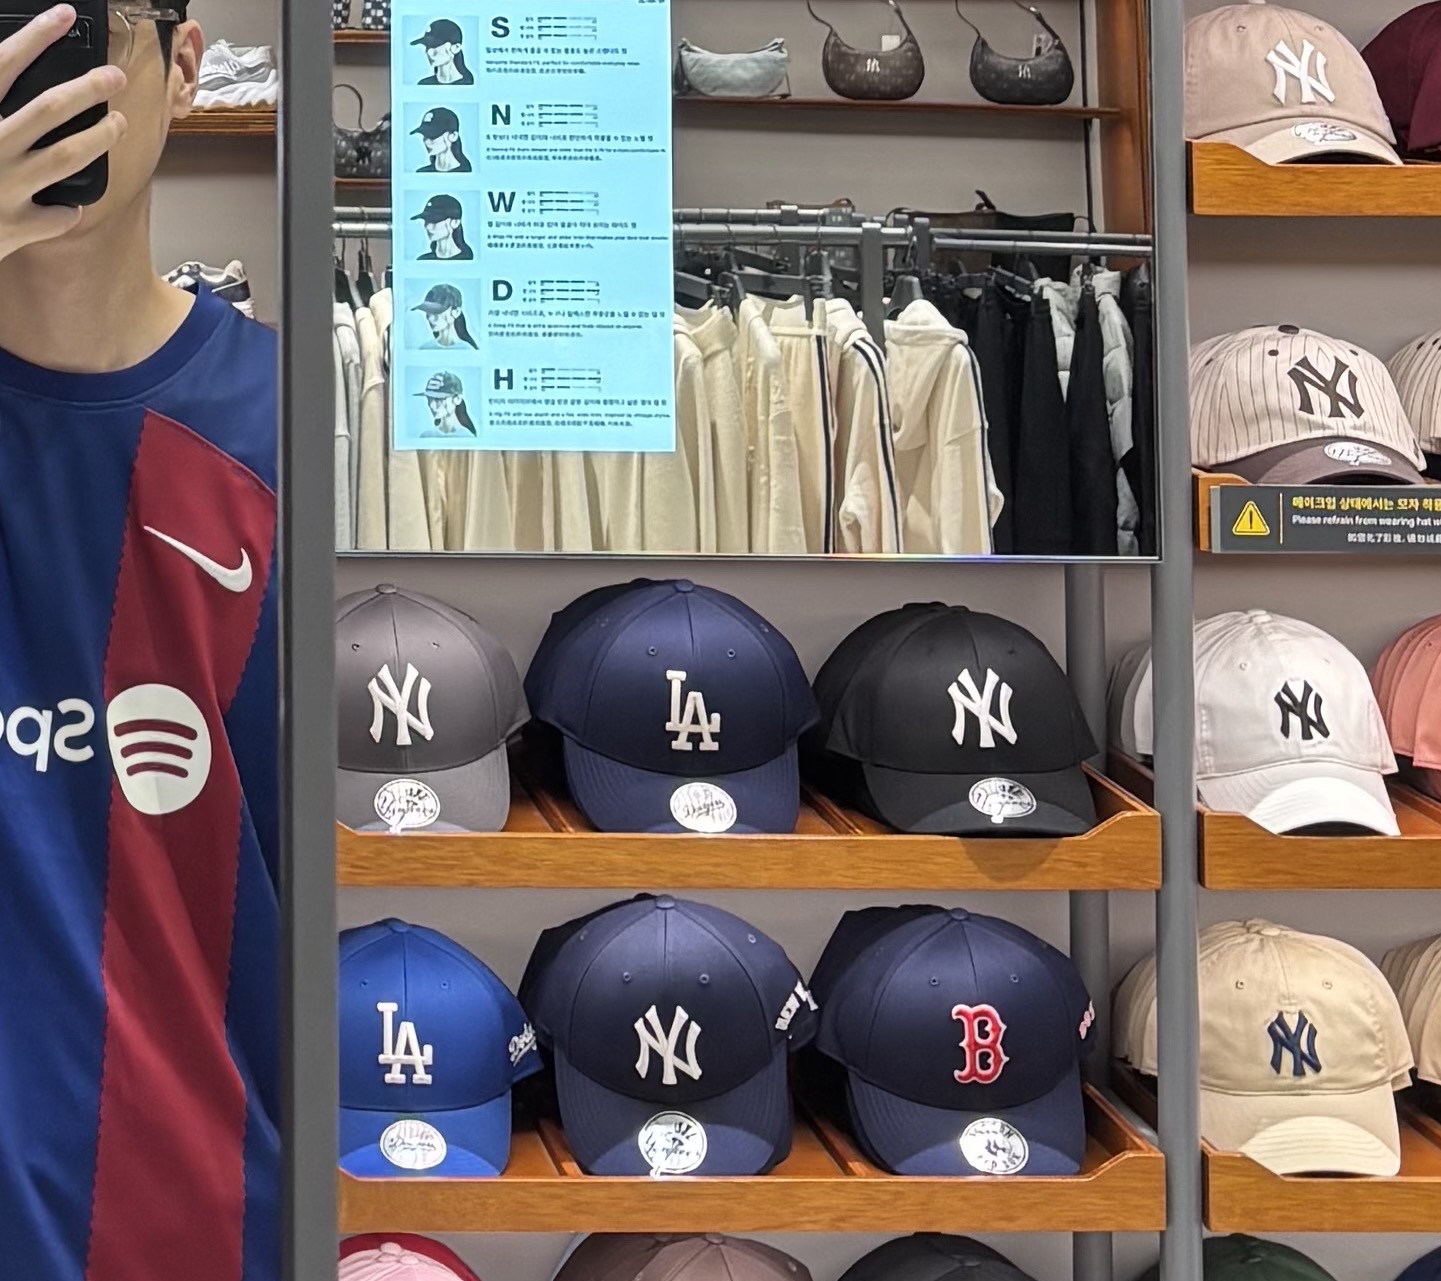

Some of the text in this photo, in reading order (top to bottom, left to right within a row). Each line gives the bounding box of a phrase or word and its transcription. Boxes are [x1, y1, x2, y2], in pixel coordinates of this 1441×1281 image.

[491, 16, 510, 38] S
[1265, 39, 1336, 105] NY
[491, 105, 510, 126] N
[488, 192, 516, 213] W
[492, 280, 512, 302] D
[494, 369, 513, 390] H
[1287, 356, 1366, 419] NY
[1292, 514, 1322, 525] Please
[1323, 514, 1354, 526] refrain
[1355, 515, 1378, 526] from
[1379, 516, 1415, 528] wearing
[1397, 497, 1420, 511] 모자
[368, 663, 435, 746] NY
[665, 669, 722, 752] LA
[946, 668, 1019, 749] NY
[1274, 679, 1331, 741] NY
[376, 1001, 433, 1084] LA
[633, 1004, 703, 1085] NY
[951, 1004, 1009, 1085] B
[1266, 1010, 1323, 1077] NY
